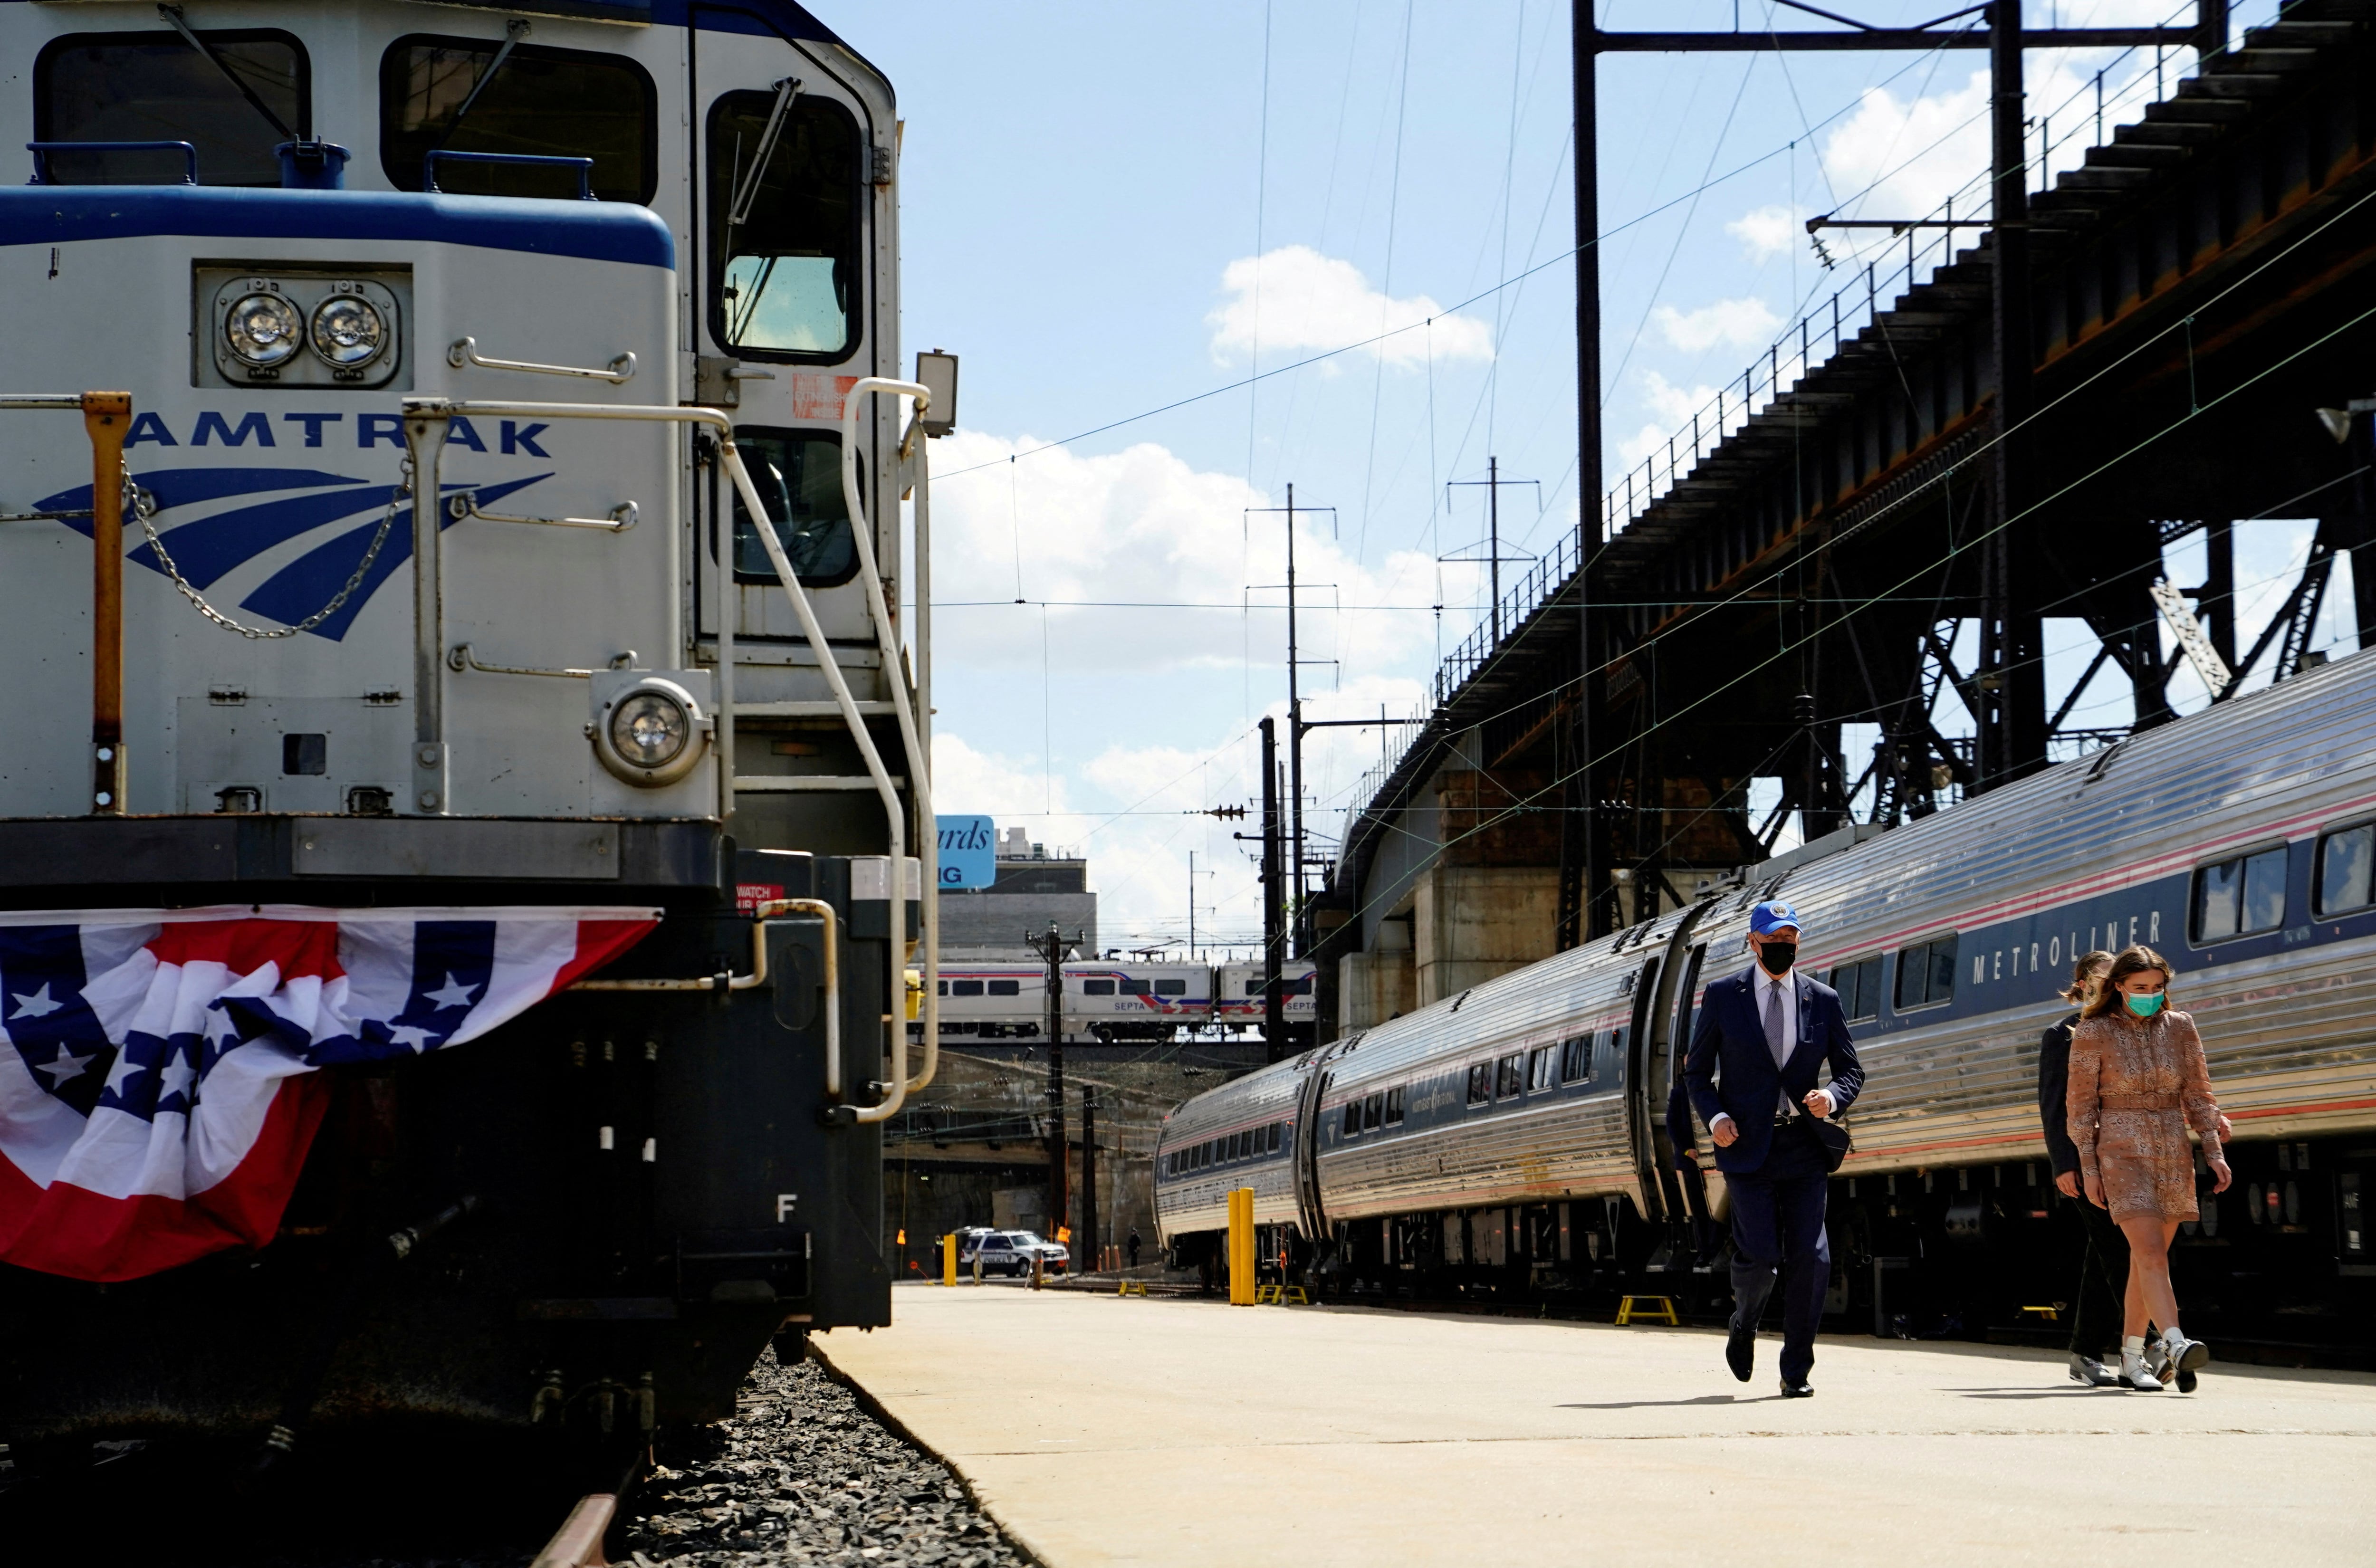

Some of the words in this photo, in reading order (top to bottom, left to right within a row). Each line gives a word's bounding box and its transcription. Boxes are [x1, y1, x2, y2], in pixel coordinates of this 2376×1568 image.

[795, 391, 846, 403] EXTINGUISH
[123, 412, 551, 458] AMTRAK
[736, 886, 771, 899] WATCH
[736, 900, 752, 909] UR
[1974, 911, 2160, 985] METROLINER
[1287, 1002, 1316, 1010] SEPTA
[777, 1194, 798, 1223] F
